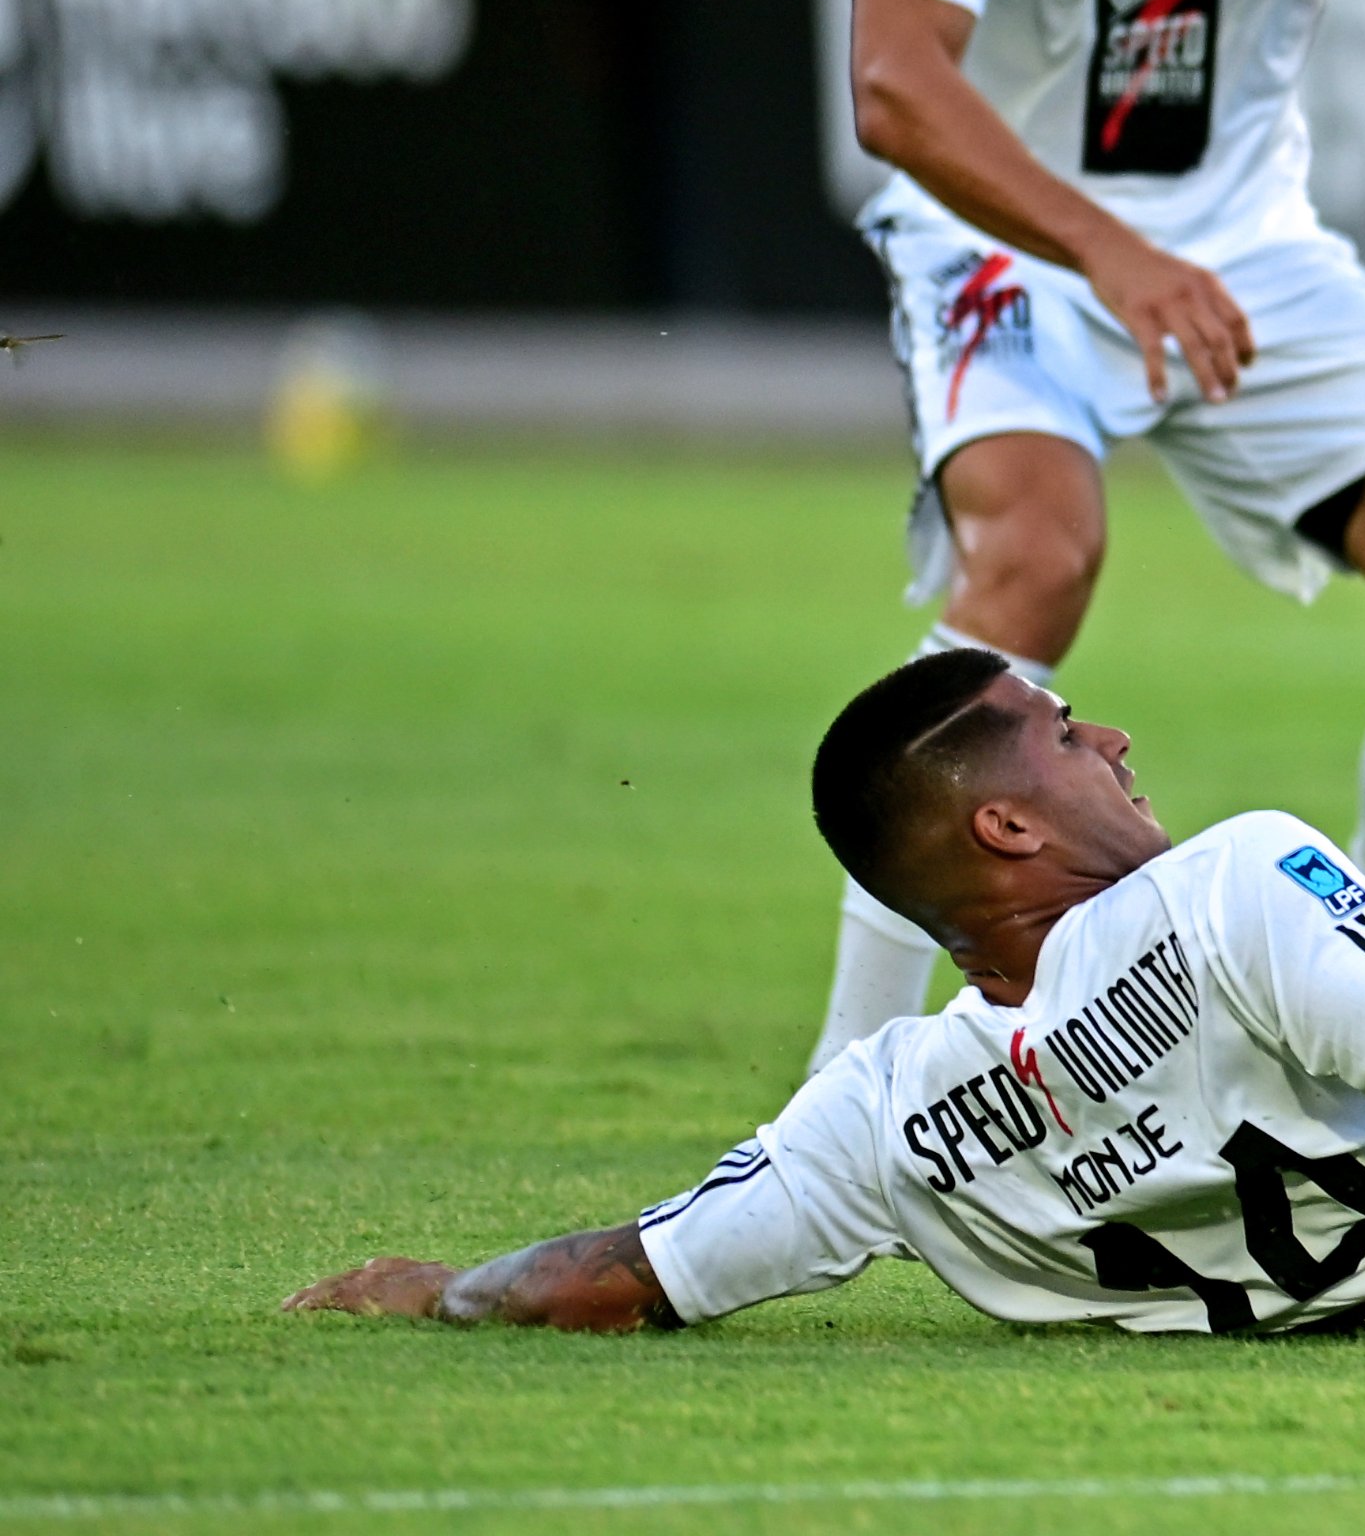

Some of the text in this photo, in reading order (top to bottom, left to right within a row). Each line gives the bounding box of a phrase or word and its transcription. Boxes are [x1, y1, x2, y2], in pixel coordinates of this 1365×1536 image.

[1324, 884, 1364, 916] LPF
[903, 1063, 1047, 1194] SPEED
[1051, 1104, 1184, 1216] MONJE
